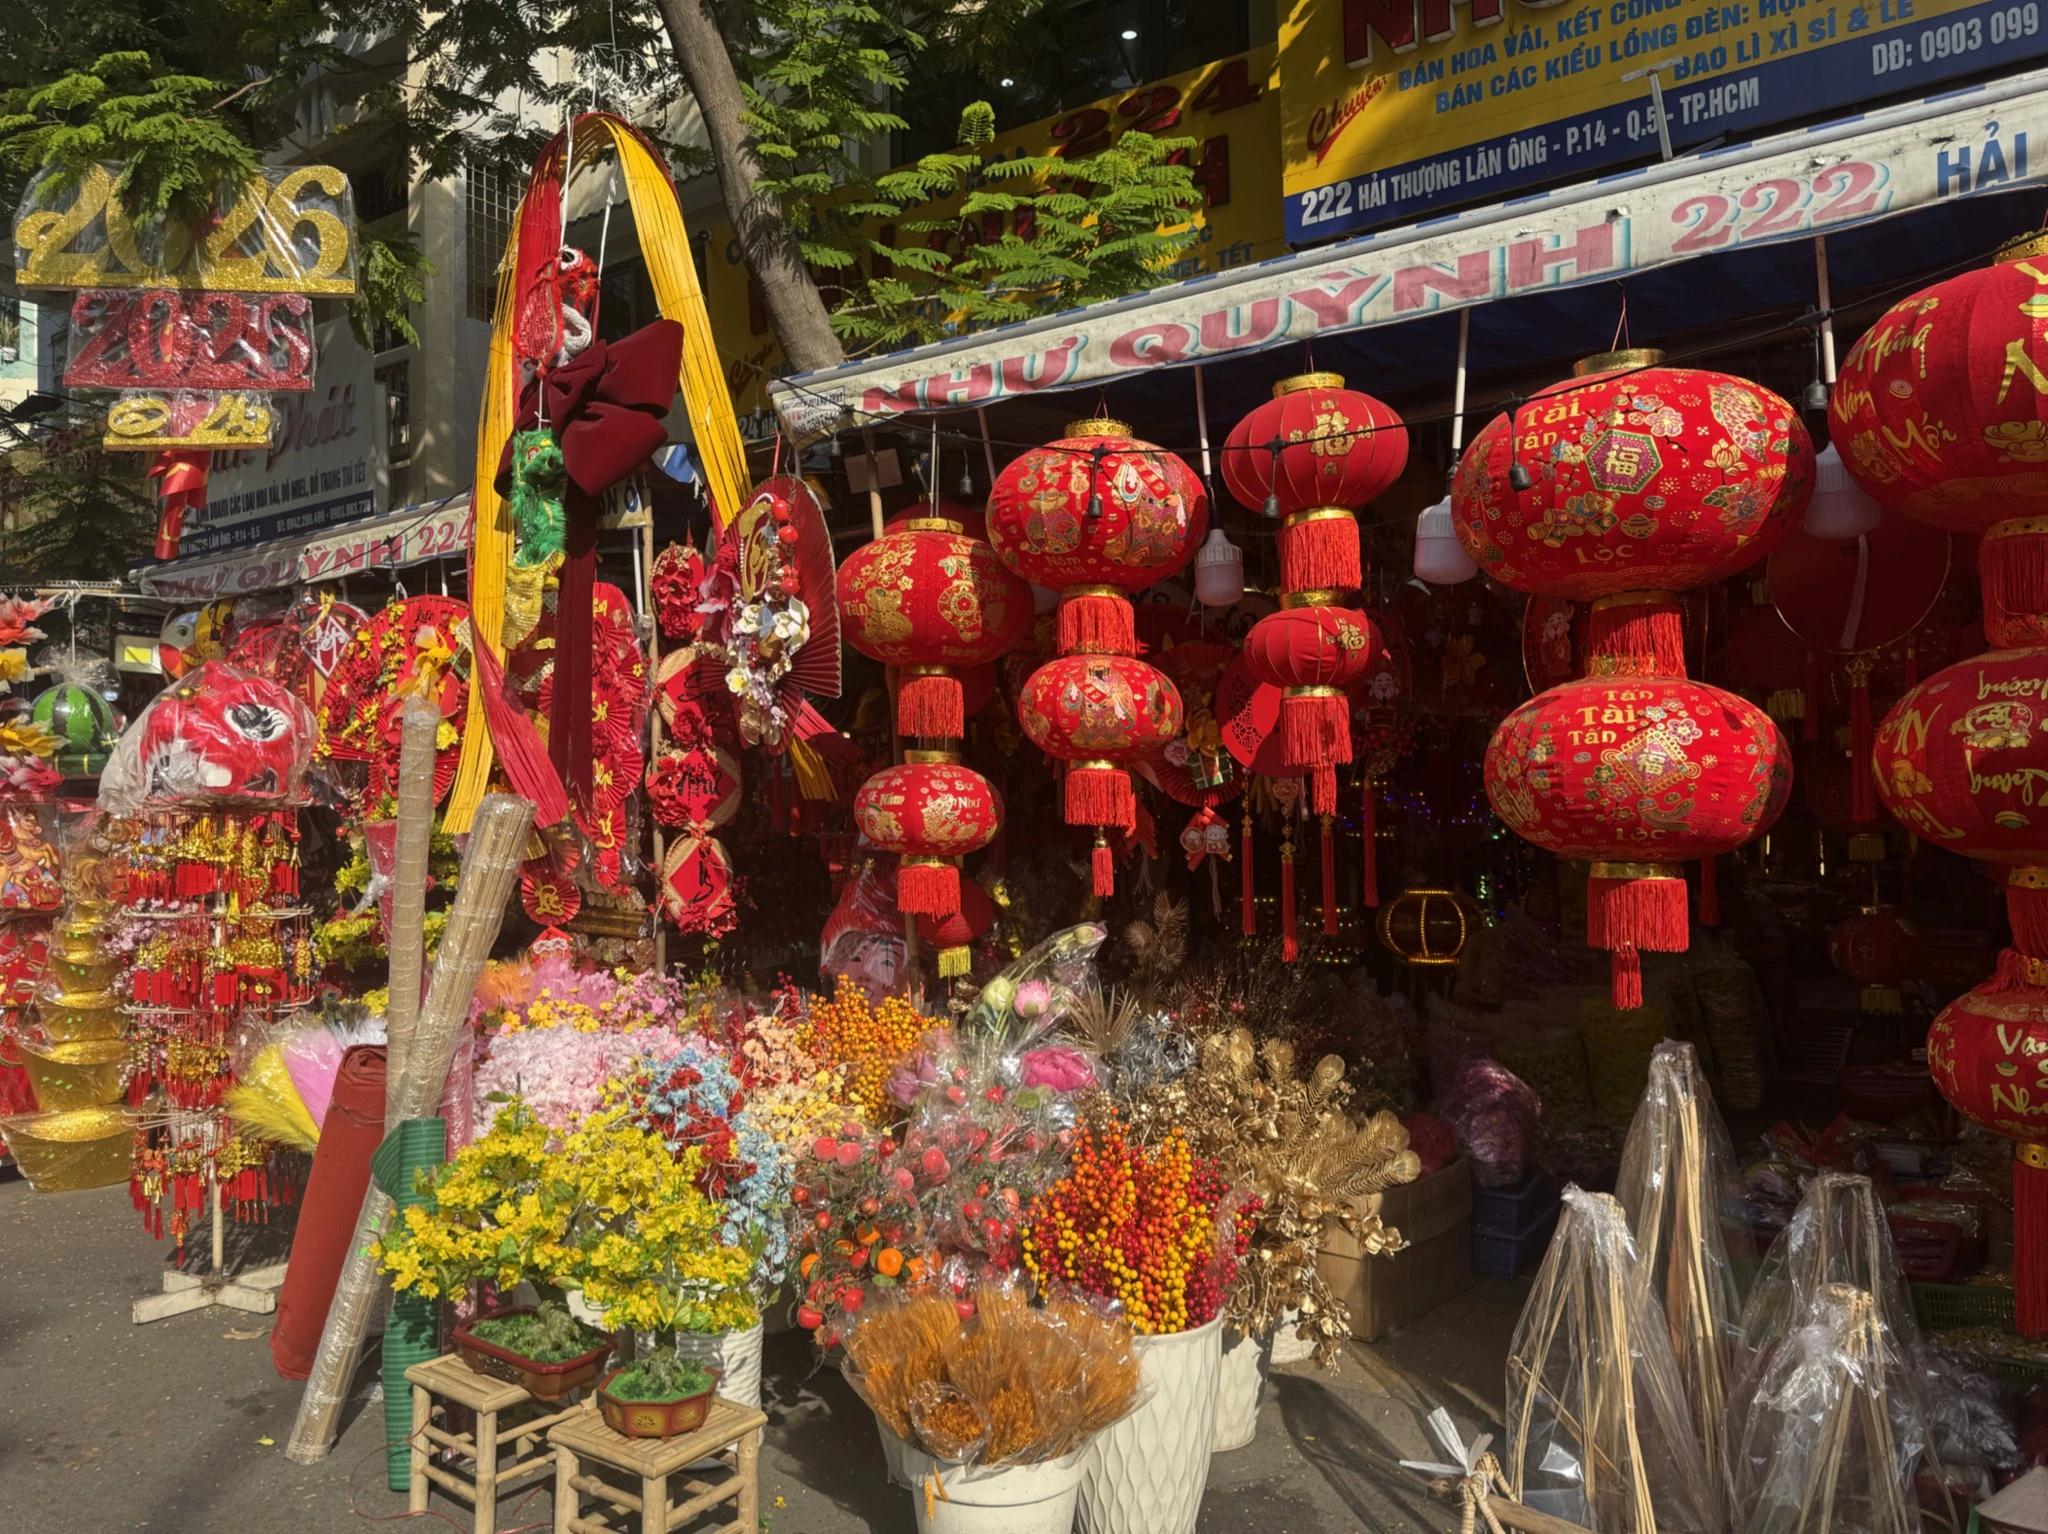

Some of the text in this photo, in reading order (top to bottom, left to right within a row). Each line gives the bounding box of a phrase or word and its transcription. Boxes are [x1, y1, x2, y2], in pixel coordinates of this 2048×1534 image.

[1398, 60, 1444, 92] BÁN
[1451, 43, 1497, 74] HOA
[1557, 5, 1602, 43] KẾT
[1673, 45, 1727, 81] BAO
[1737, 31, 1760, 63] LÌ
[1770, 21, 1798, 54] XÌ
[1872, 3, 2039, 76] DĐ: 0903 099
[1435, 82, 1482, 114] BÁN
[1490, 60, 1537, 97] CÁC
[1545, 41, 1601, 81] KIỂU
[1301, 180, 1353, 227] 222
[1358, 171, 1387, 212] HẢI
[1391, 157, 1461, 201] THƯỢNG
[1465, 144, 1502, 181] LÃN
[1507, 134, 1547, 171] ÔNG
[1566, 120, 1606, 156] P.14
[1626, 104, 1658, 143] Q.5
[1679, 76, 1760, 126] TP.HCM
[864, 335, 1088, 412] NHƯ
[1671, 161, 1894, 253] 222
[1936, 120, 2028, 198] HẢI
[1521, 398, 1580, 429] Tài
[1605, 443, 1643, 478] 福
[419, 522, 469, 557] 224
[1603, 689, 1655, 701] Tấn
[1576, 704, 1637, 727] Tài
[1568, 727, 1617, 747] Tấn
[1637, 748, 1666, 778] 福
